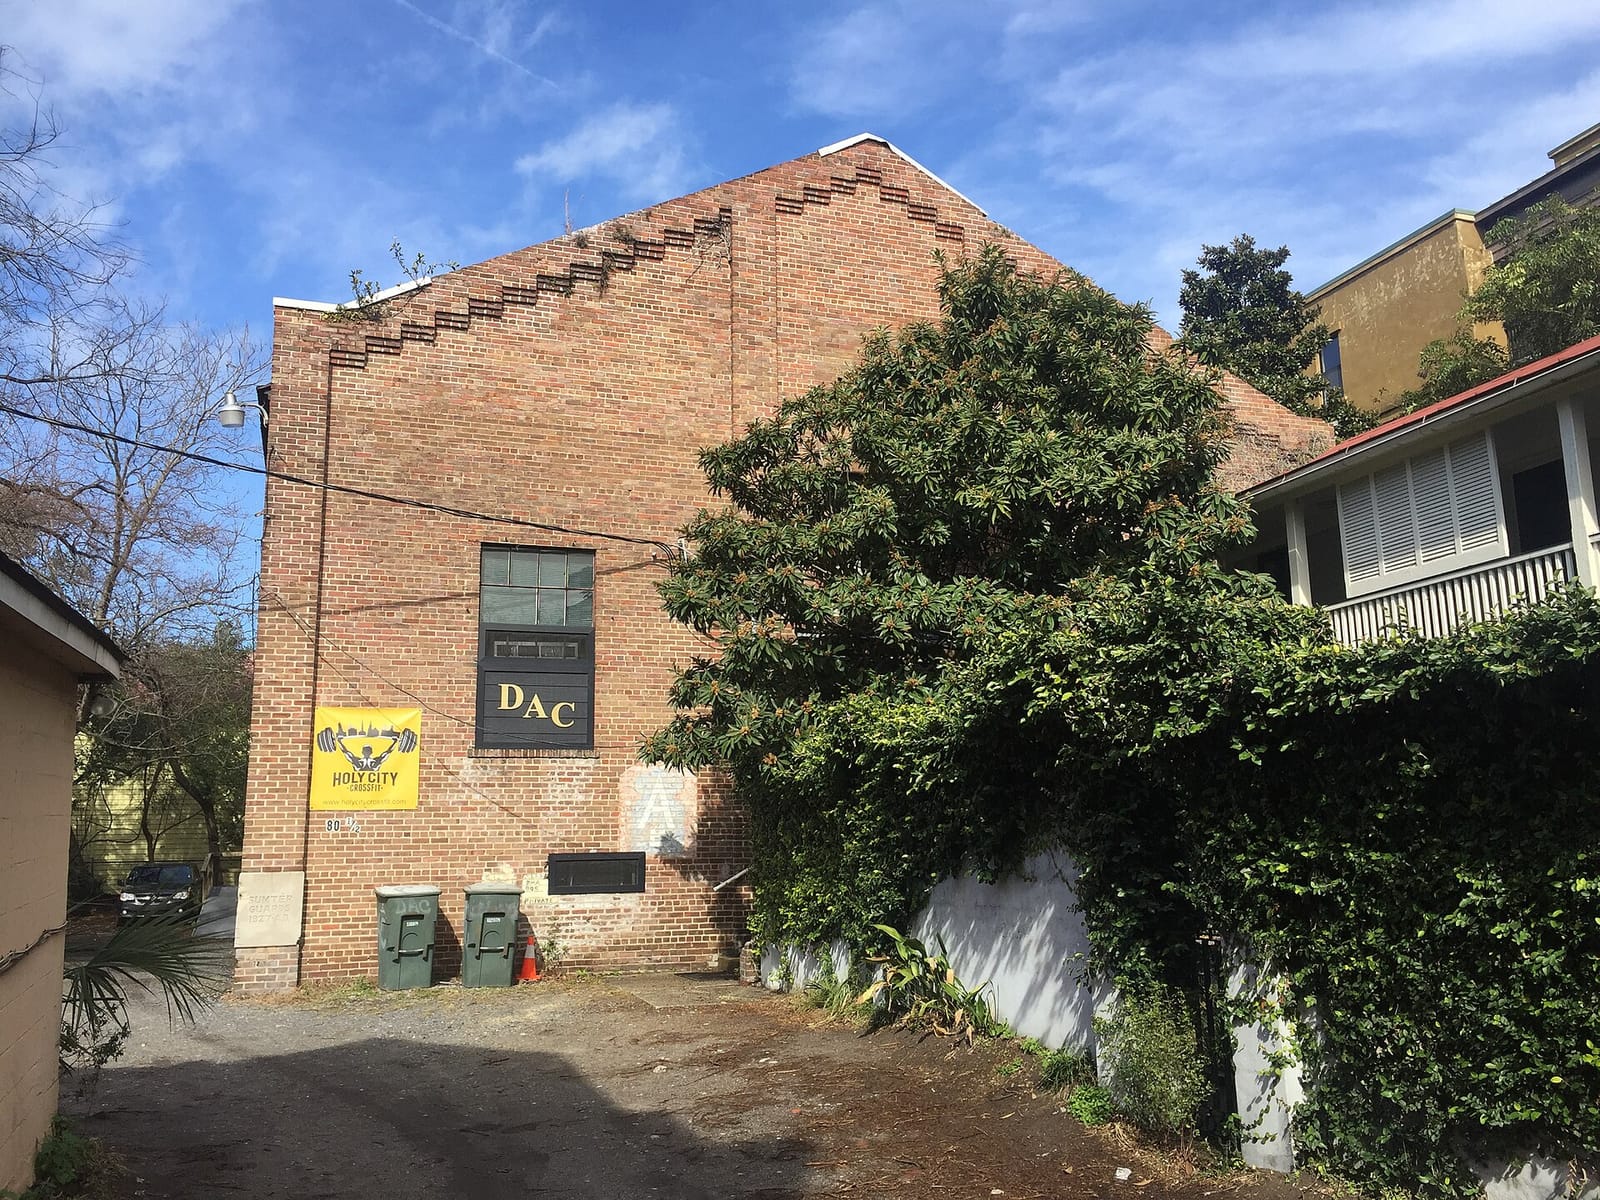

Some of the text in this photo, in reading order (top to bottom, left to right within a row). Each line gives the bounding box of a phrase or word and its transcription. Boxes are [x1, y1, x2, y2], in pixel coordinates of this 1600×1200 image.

[497, 683, 576, 728] DAC
[332, 771, 399, 788] HOLY CITY
[326, 820, 340, 832] 80
[248, 895, 293, 904] SUMTER
